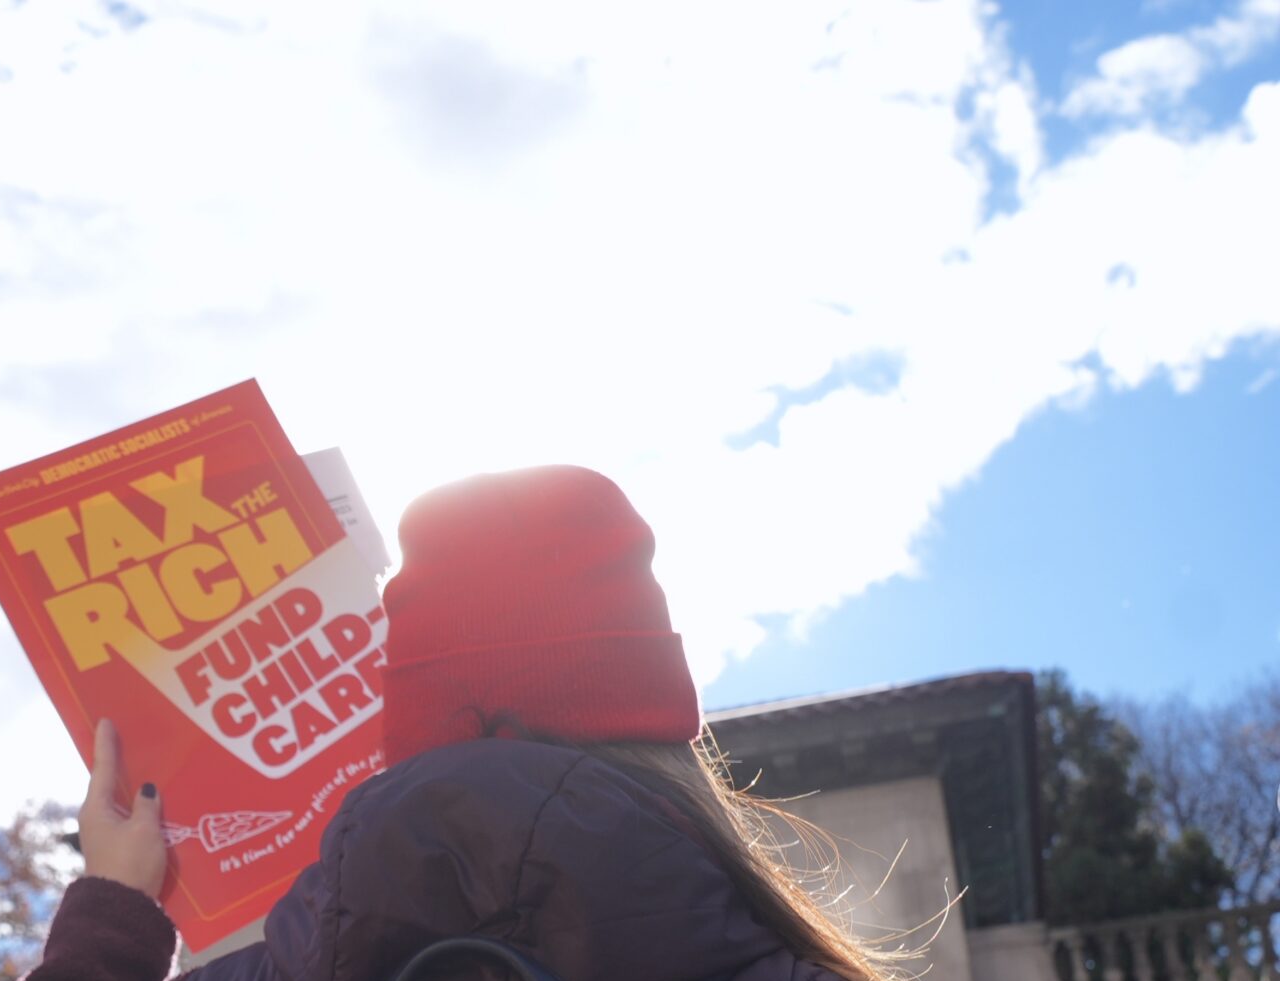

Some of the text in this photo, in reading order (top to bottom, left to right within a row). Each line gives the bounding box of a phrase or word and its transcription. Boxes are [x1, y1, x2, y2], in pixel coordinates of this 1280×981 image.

[39, 444, 121, 485] DEMOCRATIC
[120, 418, 191, 456] SOCIALISTS
[5, 455, 279, 593] TAX THE
[43, 507, 314, 672] RICH
[174, 588, 324, 709] FUND
[211, 605, 386, 740] CHILD-
